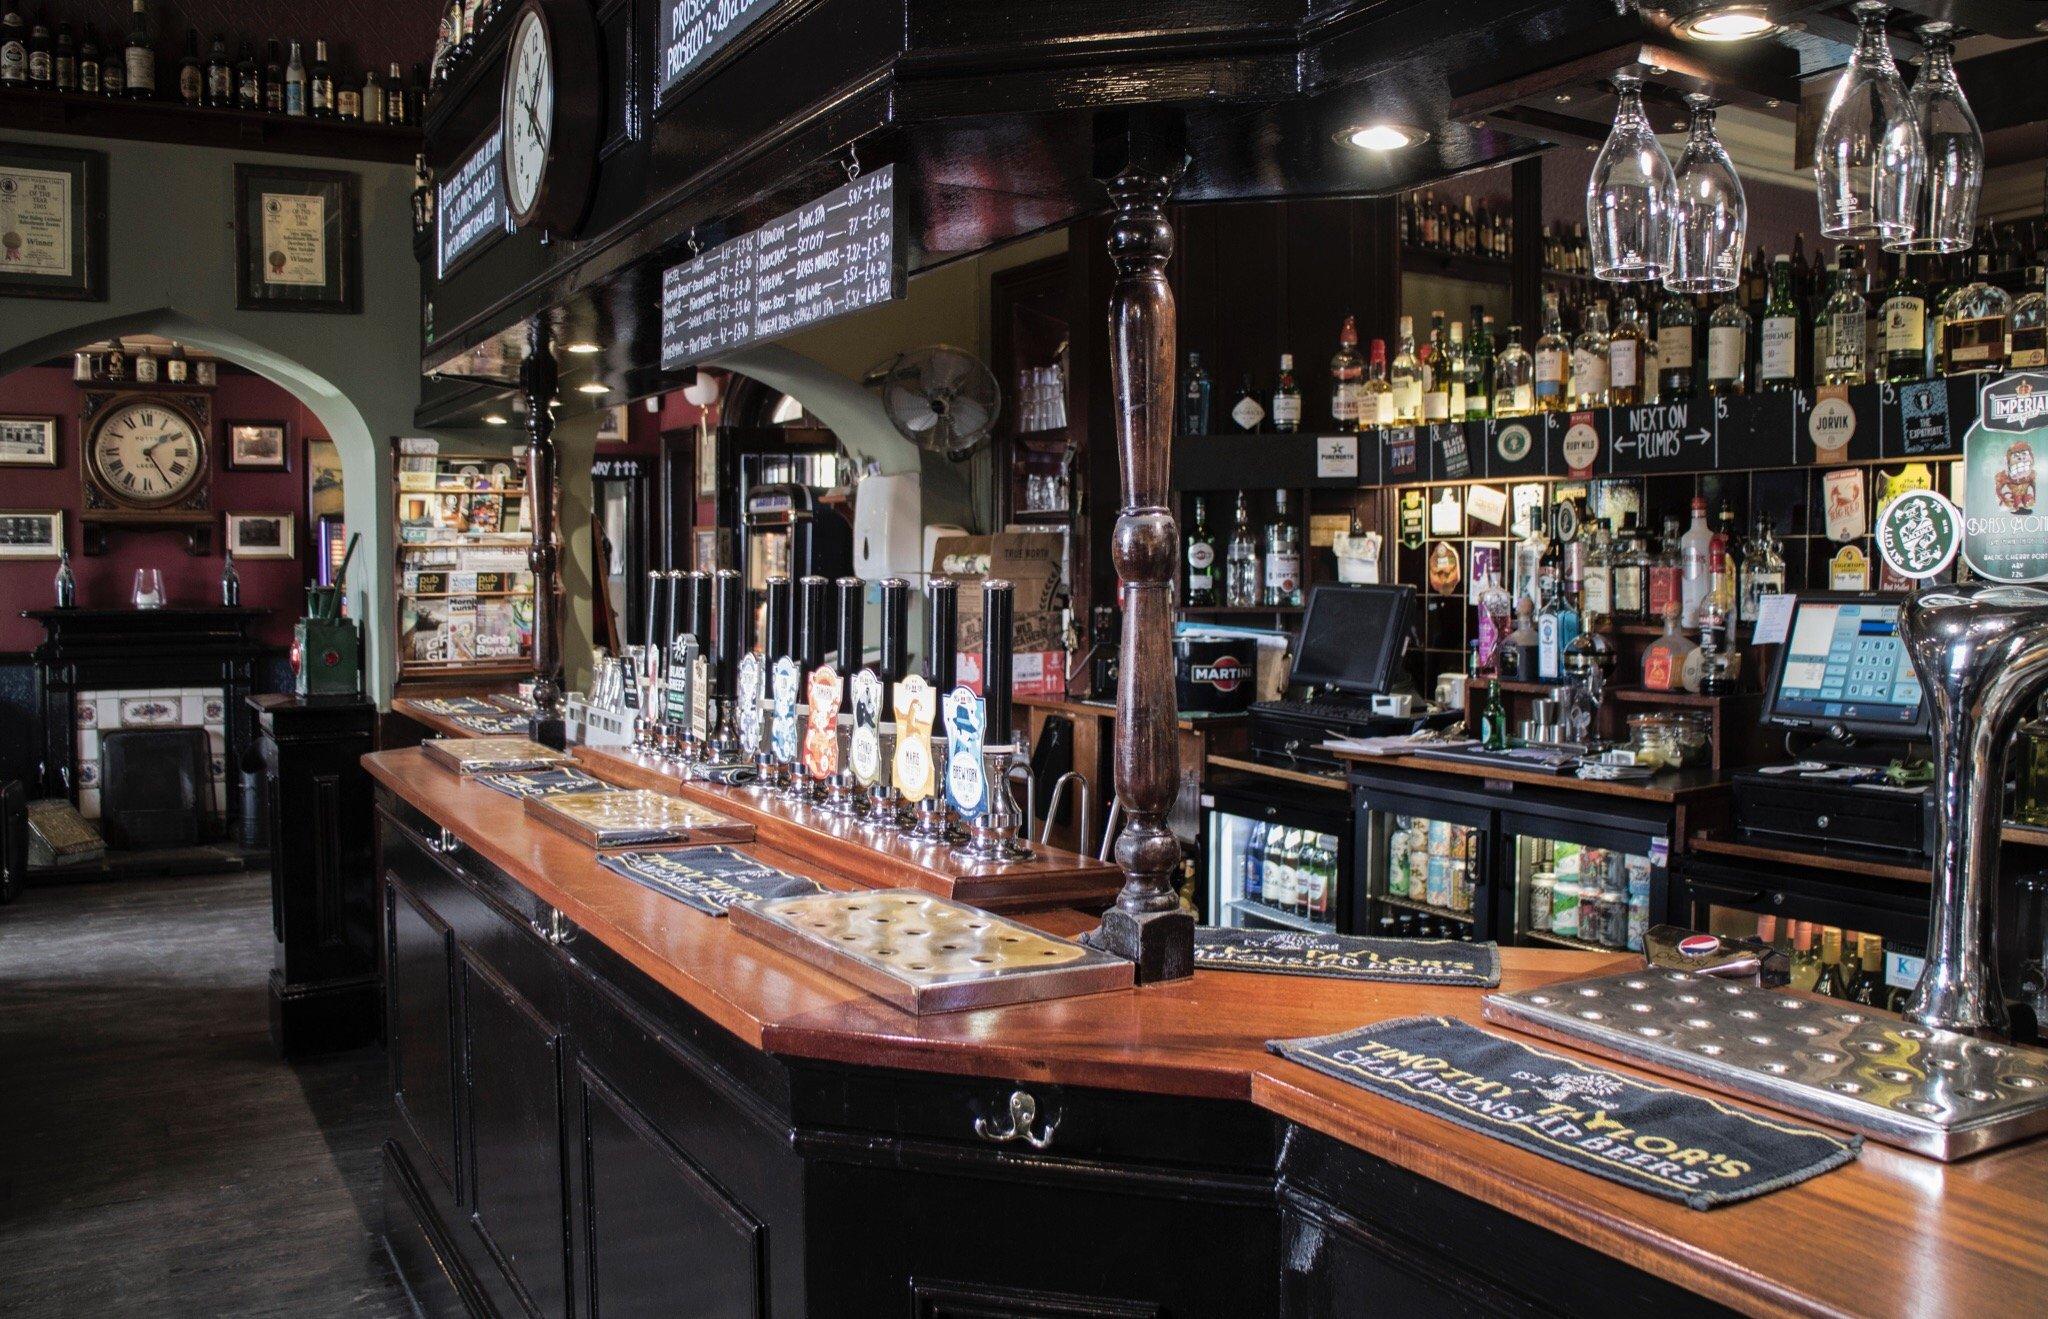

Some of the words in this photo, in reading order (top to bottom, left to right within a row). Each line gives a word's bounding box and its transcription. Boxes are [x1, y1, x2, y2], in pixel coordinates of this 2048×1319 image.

[667, 20, 704, 81] PROSECCO
[760, 225, 785, 250] BREWDOG
[869, 173, 892, 199] £4.60
[809, 230, 824, 250] CITY
[866, 203, 890, 229] £5.00
[27, 239, 53, 247] Winner
[796, 256, 814, 280] BRASS
[866, 231, 890, 261] £5.30
[864, 260, 887, 282] £4.70
[865, 280, 890, 304] £4.50
[1629, 405, 1667, 432] NEXT
[1668, 403, 1688, 429] ON
[1816, 415, 1849, 430] JORVIK
[1919, 417, 1931, 427] THE
[1908, 425, 1944, 440] EXPATRIATE
[1442, 435, 1464, 449] BLACK
[1566, 442, 1580, 450] RUBY
[1581, 440, 1594, 449] MILD
[1638, 430, 1680, 460] PUMPS
[1445, 444, 1466, 459] SHEEP
[1967, 517, 2006, 536] BRASS
[1885, 526, 1894, 548] CITY
[1889, 549, 1904, 565] SKY
[420, 574, 439, 584] pub
[478, 573, 498, 584] pub
[420, 583, 437, 592] bar
[478, 582, 495, 591] bar
[476, 634, 511, 645] Going
[476, 644, 519, 657] Beyond
[1195, 668, 1251, 680] MARTINI
[1357, 1040, 1530, 1098] TIMOTHY
[1536, 1101, 1752, 1178] TAYLOR'S
[1332, 1049, 1583, 1139] CHAMPIONSHIP
[1576, 1136, 1709, 1185] BEERS
